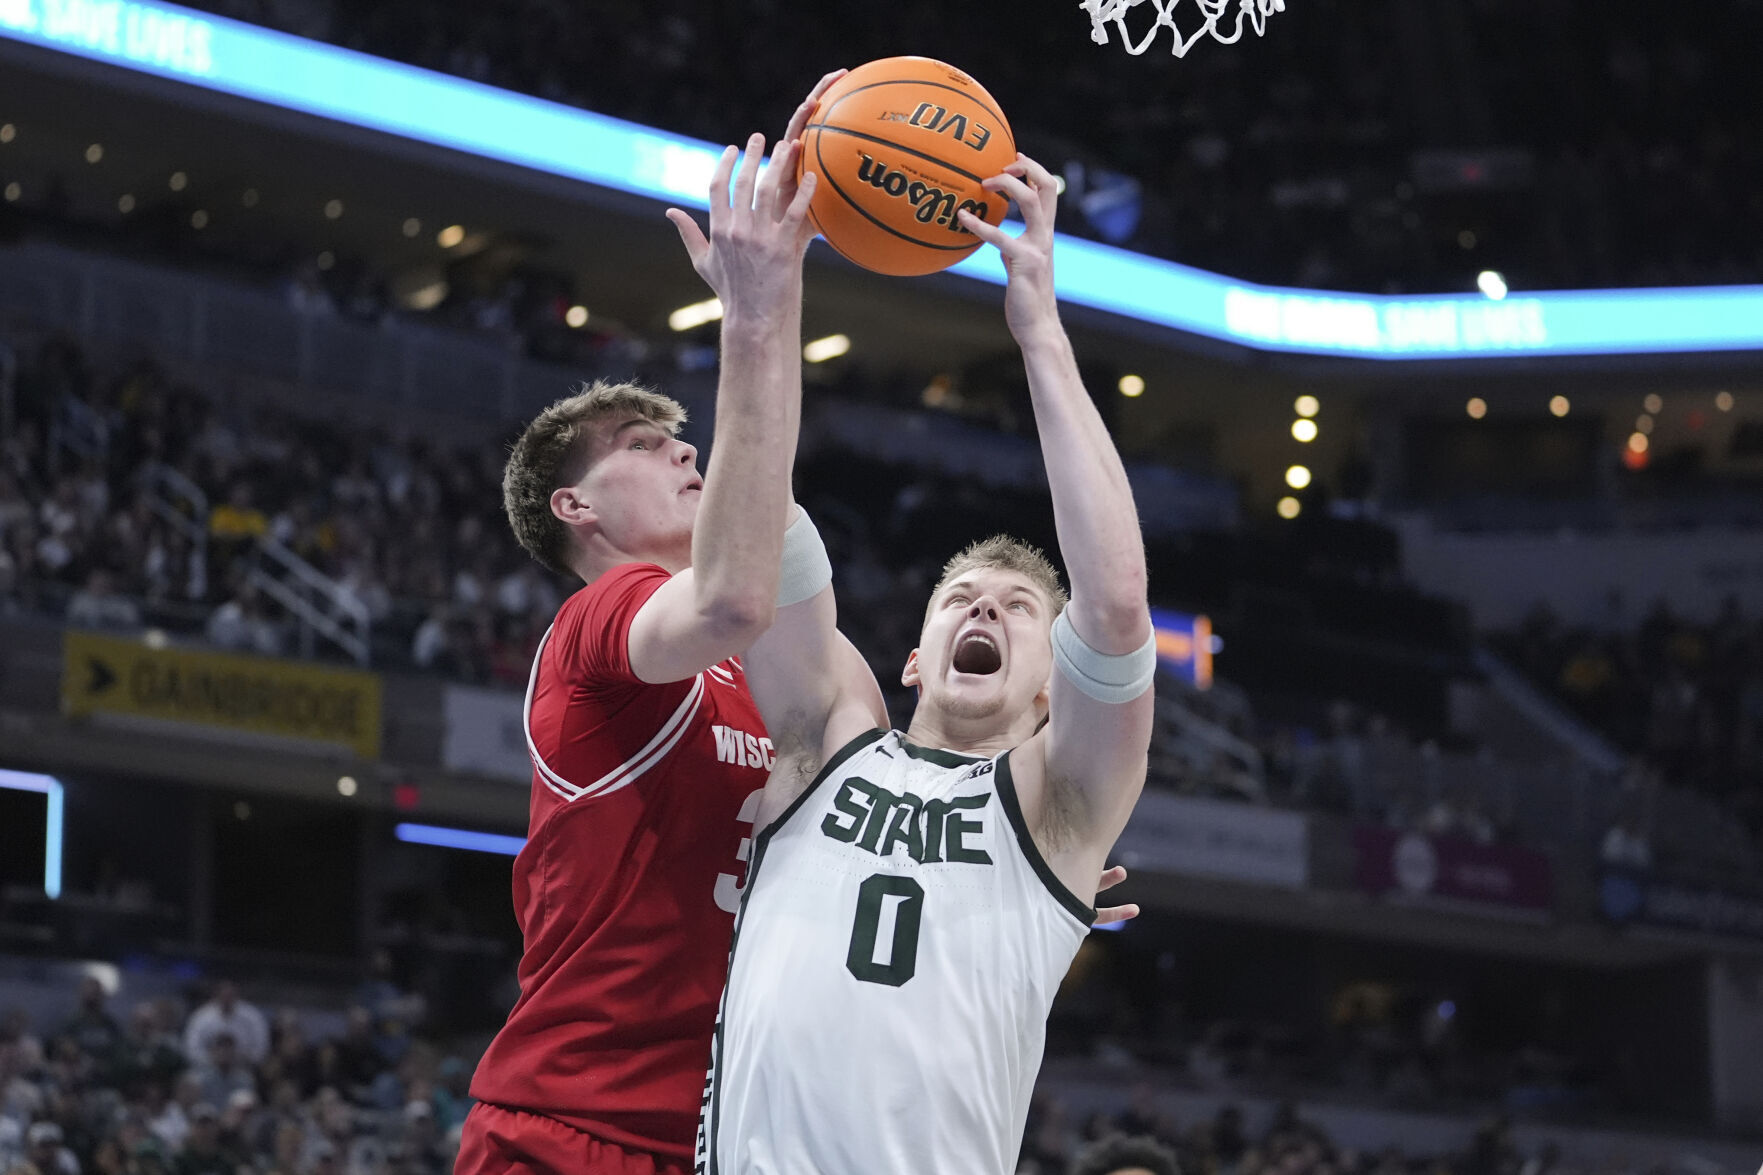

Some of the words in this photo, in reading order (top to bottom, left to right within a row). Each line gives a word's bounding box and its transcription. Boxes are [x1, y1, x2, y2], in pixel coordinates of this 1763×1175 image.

[909, 102, 991, 151] EVO
[857, 152, 989, 235] Wilson
[820, 776, 994, 866] STATE
[846, 873, 925, 988] 0
